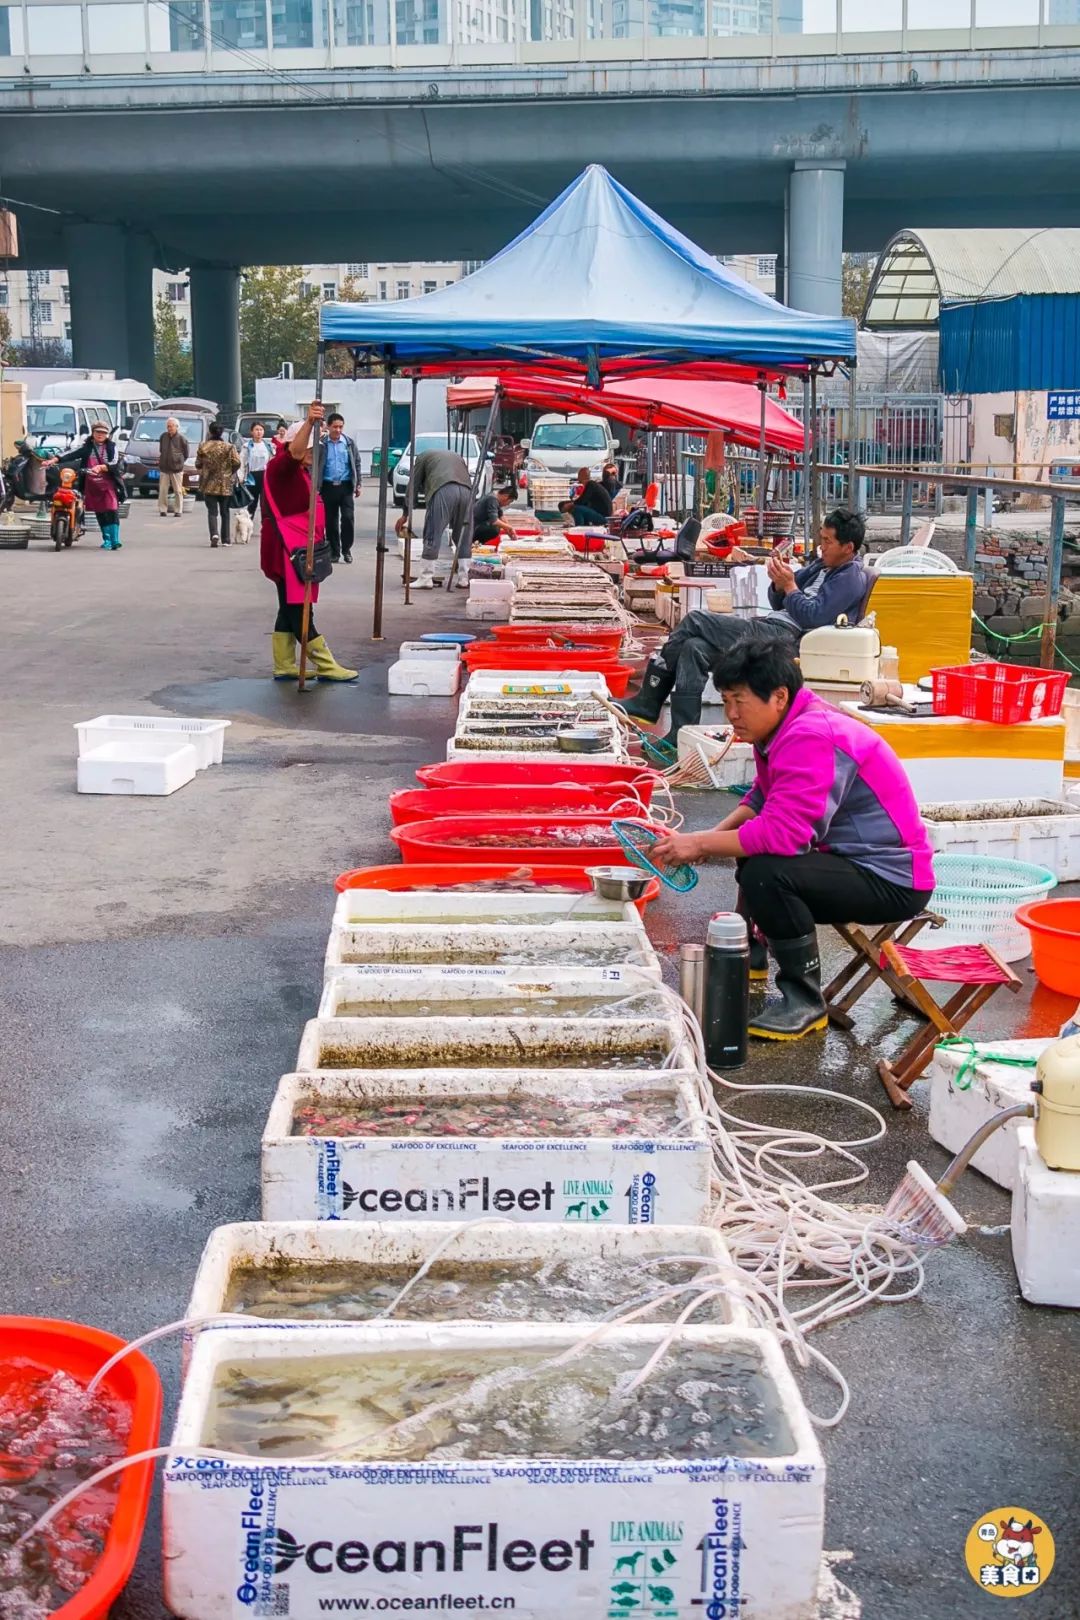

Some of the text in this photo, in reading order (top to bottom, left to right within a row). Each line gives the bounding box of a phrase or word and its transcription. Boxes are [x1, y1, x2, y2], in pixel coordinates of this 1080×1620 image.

[563, 1180, 614, 1195] LIVE ANIMALS
[166, 1471, 292, 1482] SEAFOOD OF EXCELLENCE
[329, 1470, 457, 1479] SEAFOOD OF EXCELLENCE
[493, 1468, 620, 1477] SEAFOOD OF EXCELLENCE
[654, 1465, 703, 1474] SEAFOOD
[754, 1474, 812, 1482] EXCELLENCE
[611, 1521, 684, 1541] LIVE ANIMALS
[732, 1502, 742, 1559] EXCELLENCE
[257, 1523, 595, 1574] OceanFleet
[706, 1497, 728, 1620] OceanFleet
[262, 1557, 273, 1601] SEAFOOD
[318, 1594, 515, 1610] www.oceanfleet.cn
[730, 1574, 740, 1618] SEAFOOD
